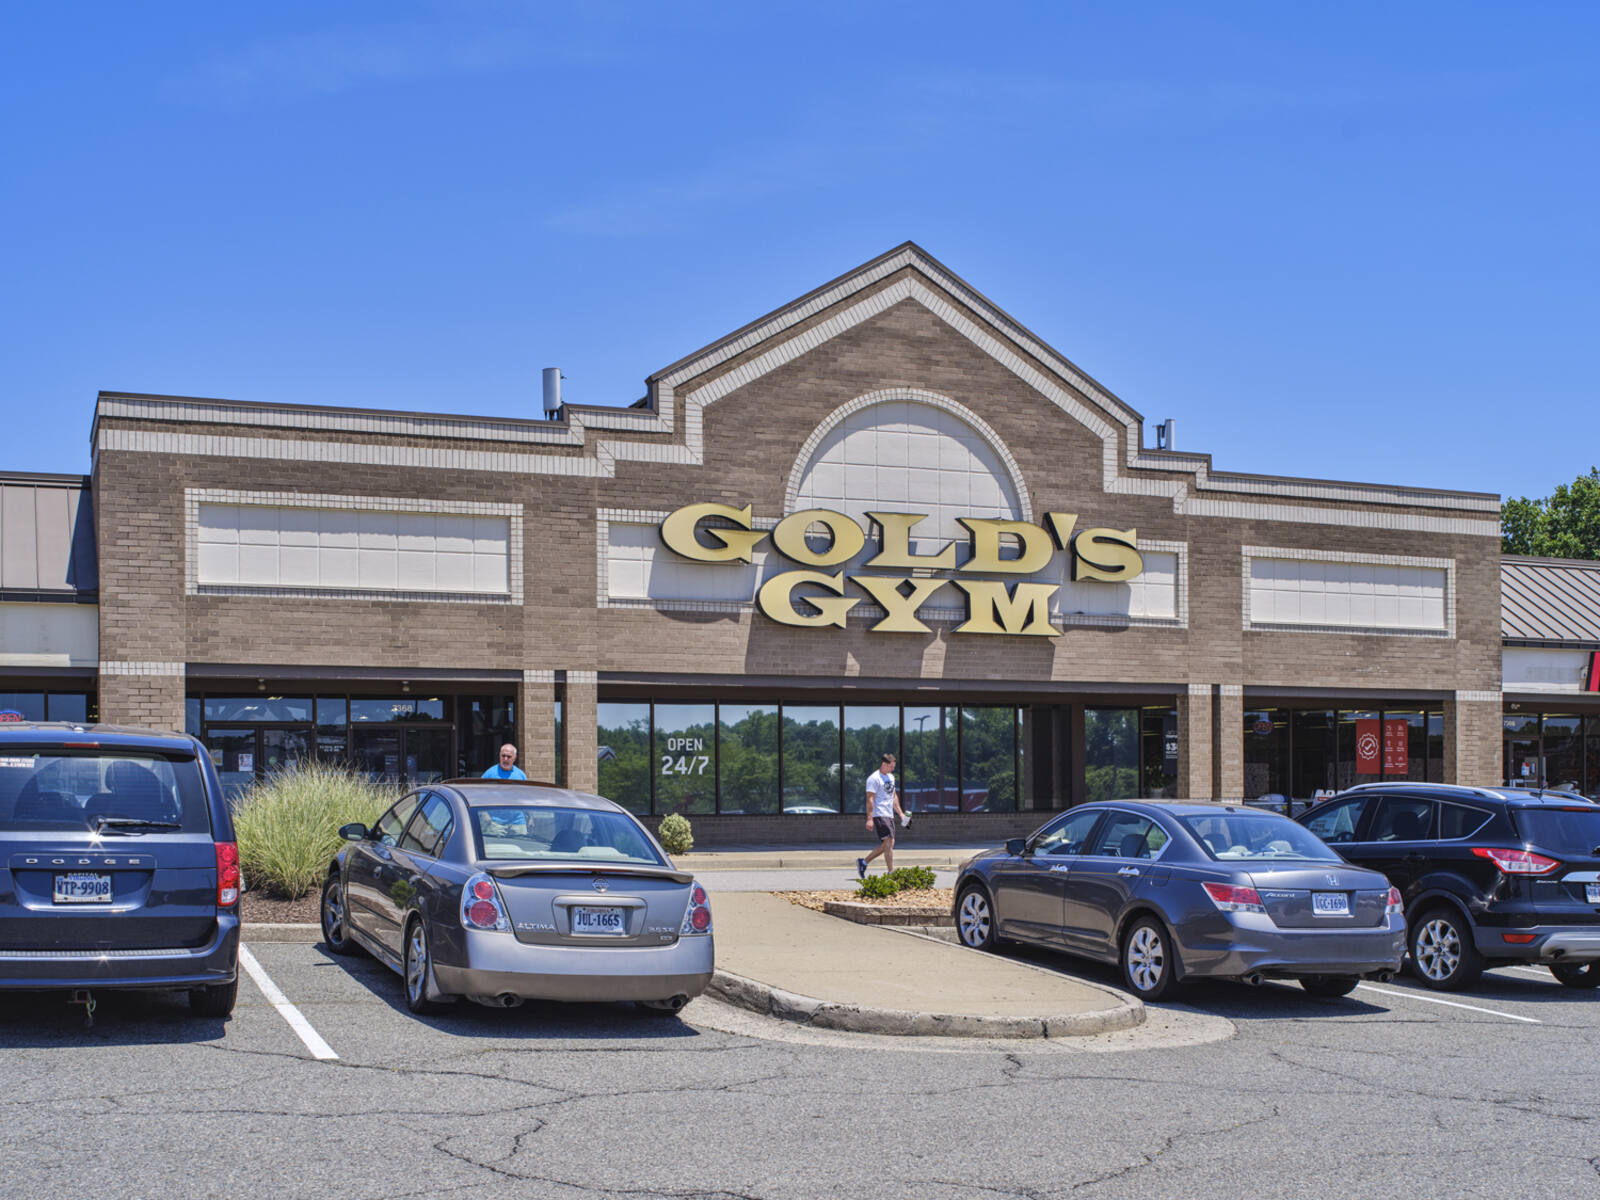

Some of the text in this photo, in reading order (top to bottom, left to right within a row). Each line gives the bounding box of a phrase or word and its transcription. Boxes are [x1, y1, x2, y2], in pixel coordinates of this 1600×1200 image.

[660, 502, 1143, 583] GOLD'S
[757, 569, 1063, 636] GYM
[667, 738, 703, 751] OPEN
[661, 755, 709, 775] 24/7
[517, 922, 555, 930] ALTIMA
[577, 910, 620, 926] JUL-1665
